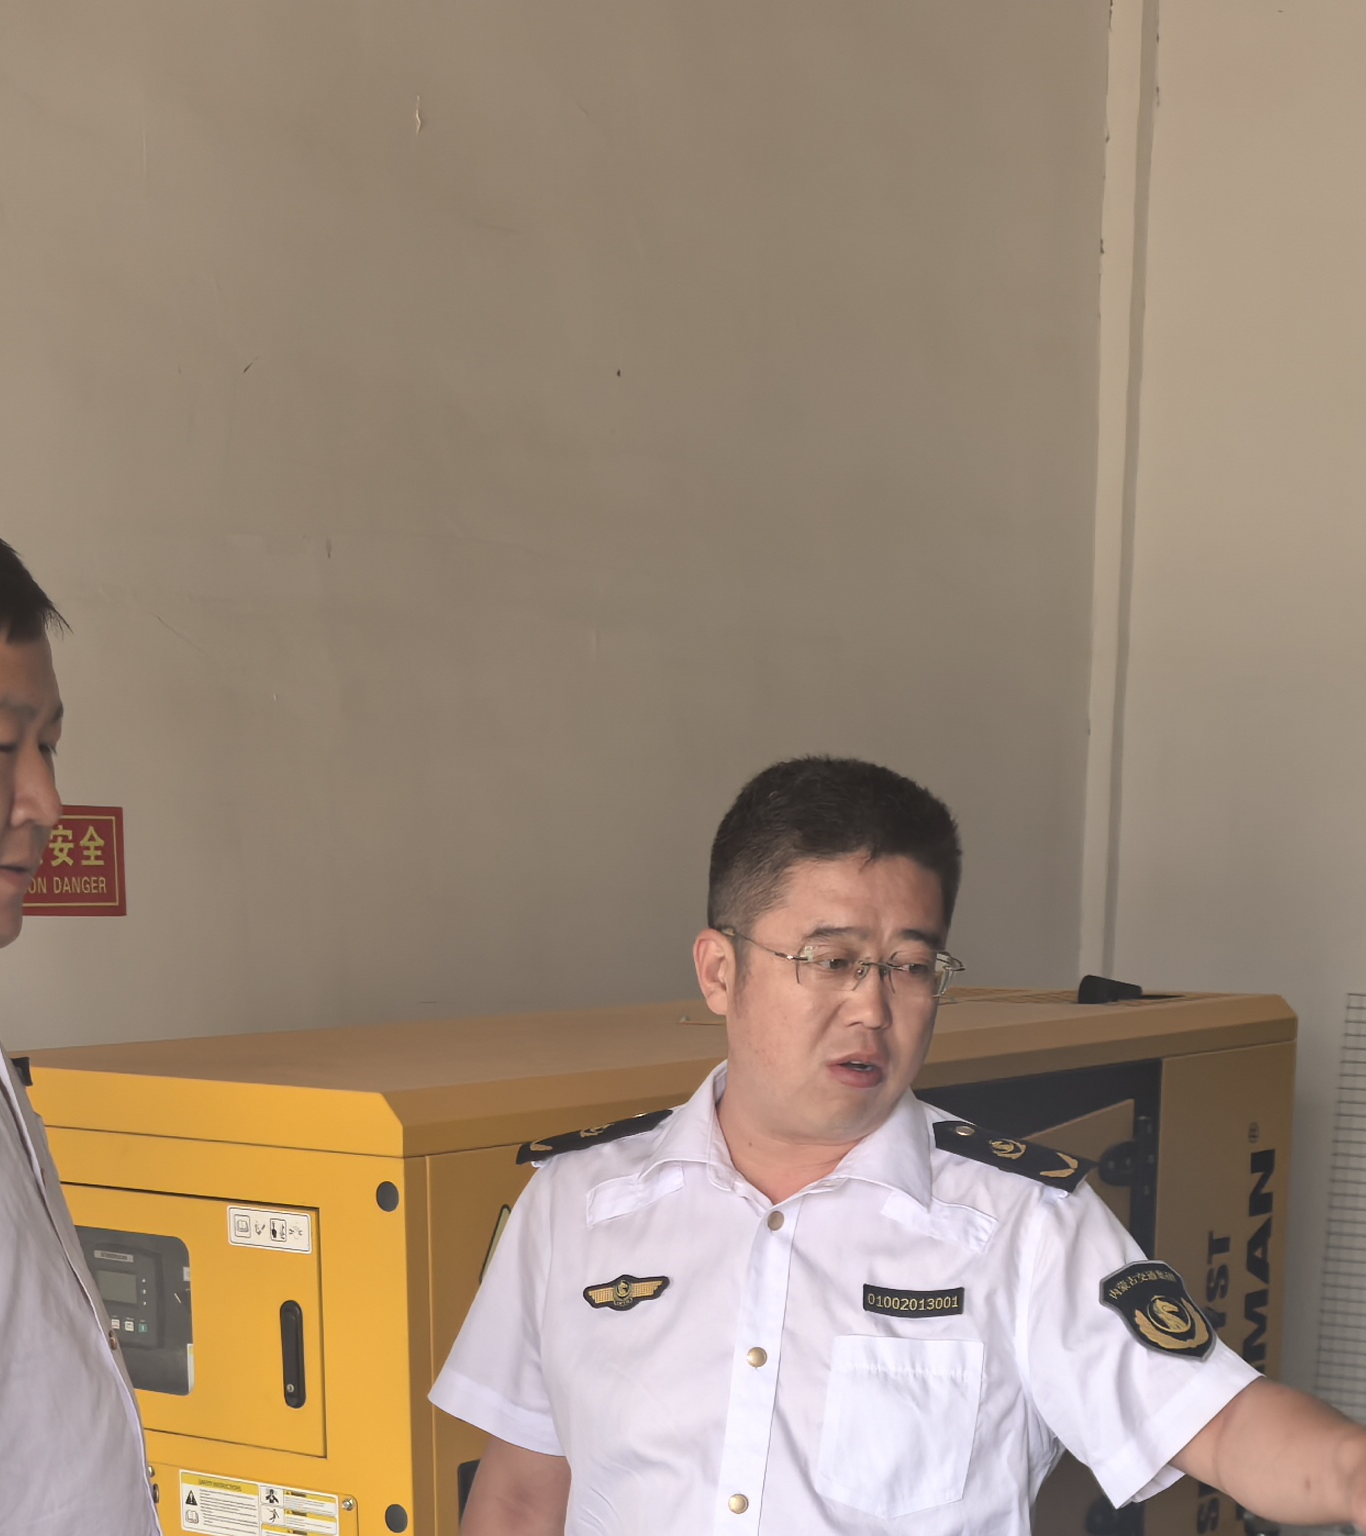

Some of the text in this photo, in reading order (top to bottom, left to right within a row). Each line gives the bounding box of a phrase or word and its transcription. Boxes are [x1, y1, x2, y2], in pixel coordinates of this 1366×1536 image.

[40, 825, 105, 866] 安全
[28, 877, 107, 894] ON DANGER
[1242, 1148, 1276, 1376] MAN
[867, 1293, 959, 1311] 01002013001
